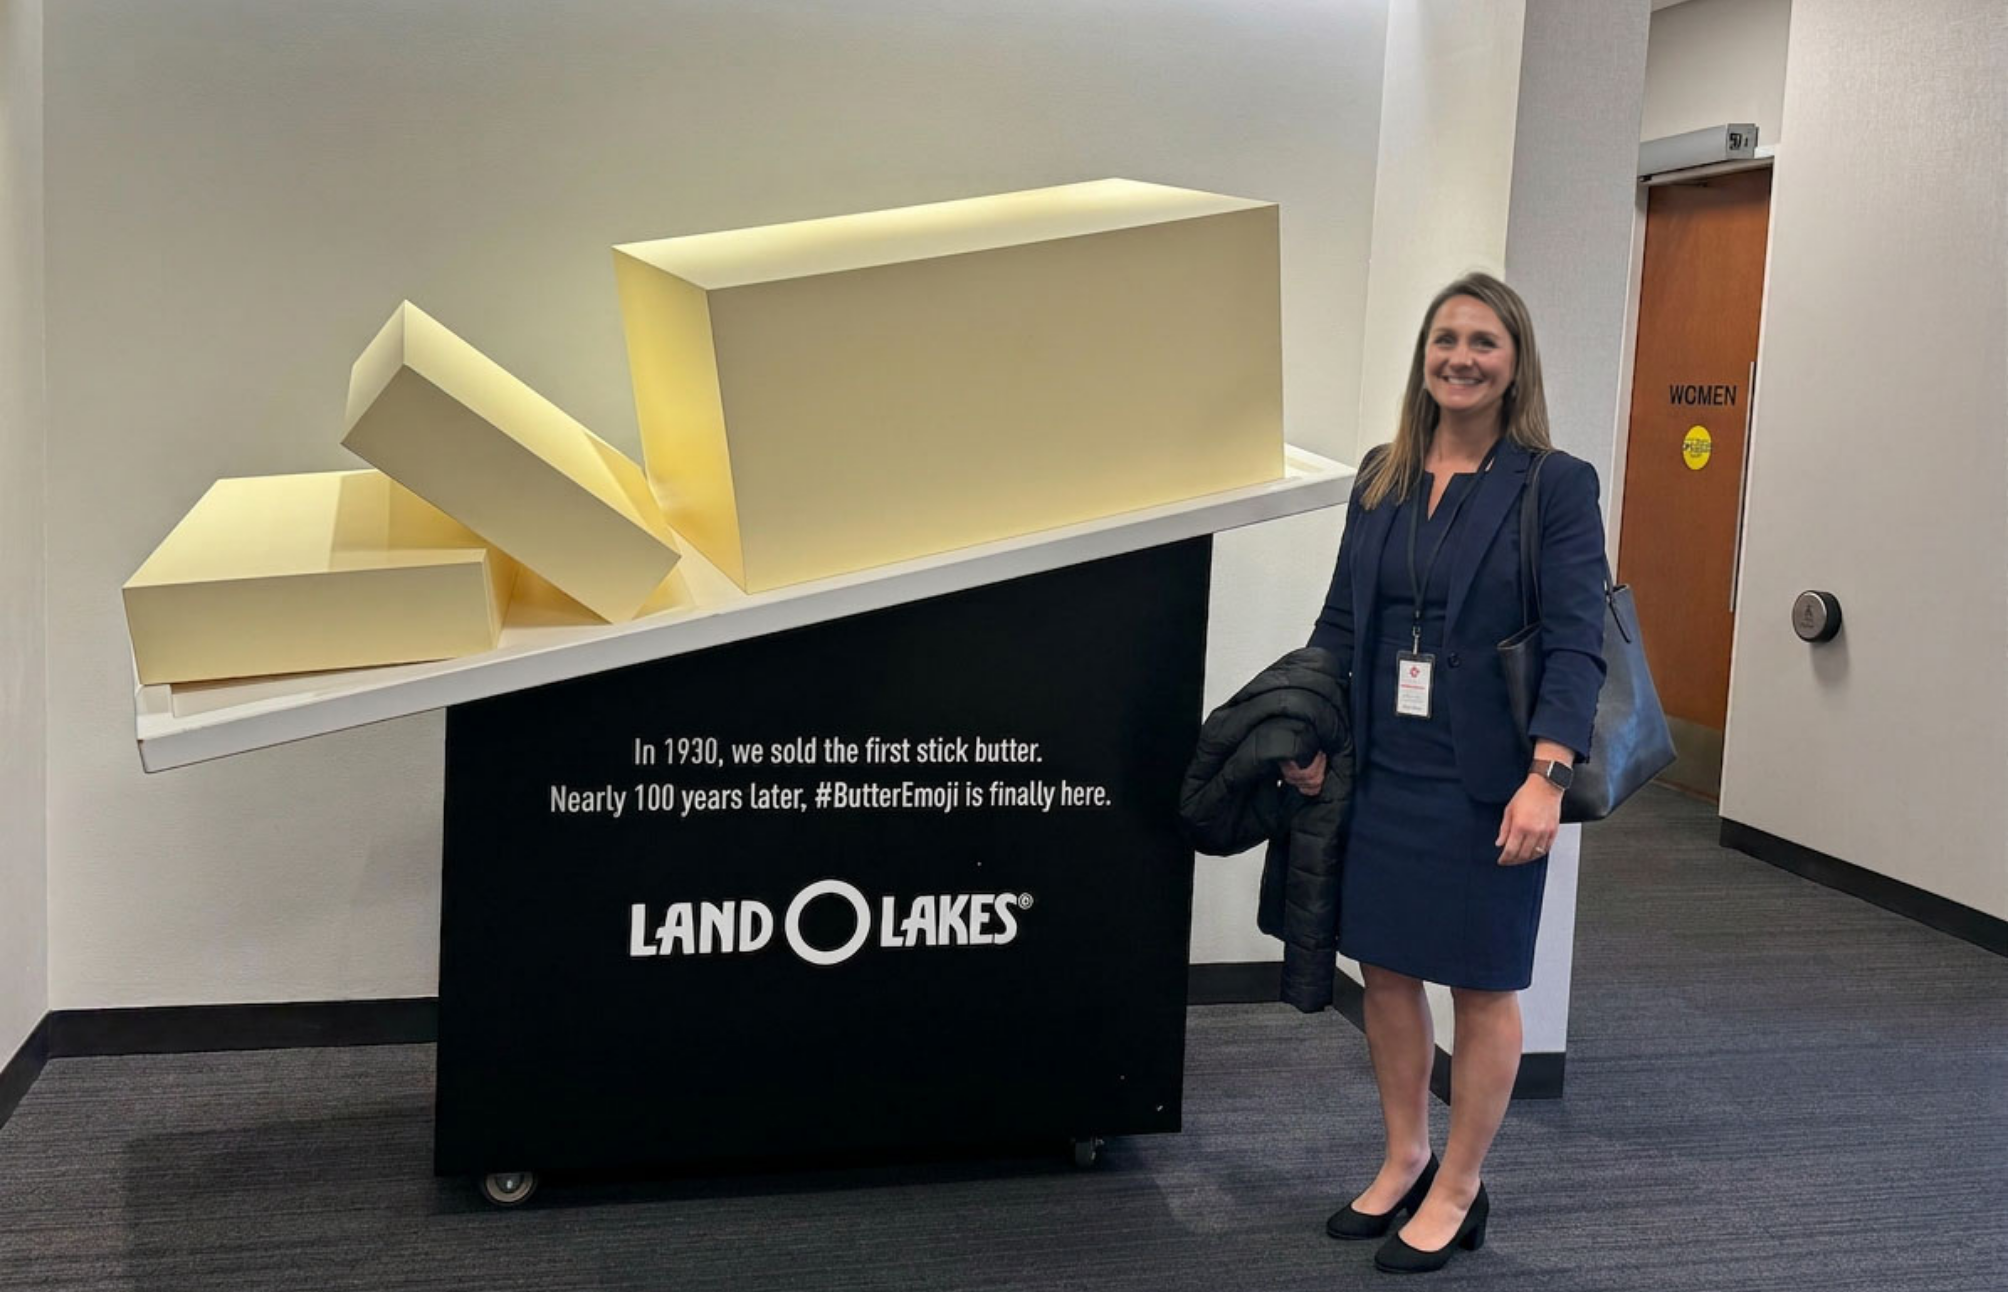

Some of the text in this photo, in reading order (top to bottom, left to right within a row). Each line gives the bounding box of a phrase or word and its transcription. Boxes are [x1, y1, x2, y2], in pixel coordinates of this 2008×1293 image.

[634, 735, 1043, 768] In 1930, we sold the first stick butter.
[550, 779, 1112, 818] Nearly 100 years later, #ButterEmoji is finally here.
[629, 899, 774, 957] LAND
[784, 878, 872, 966] O
